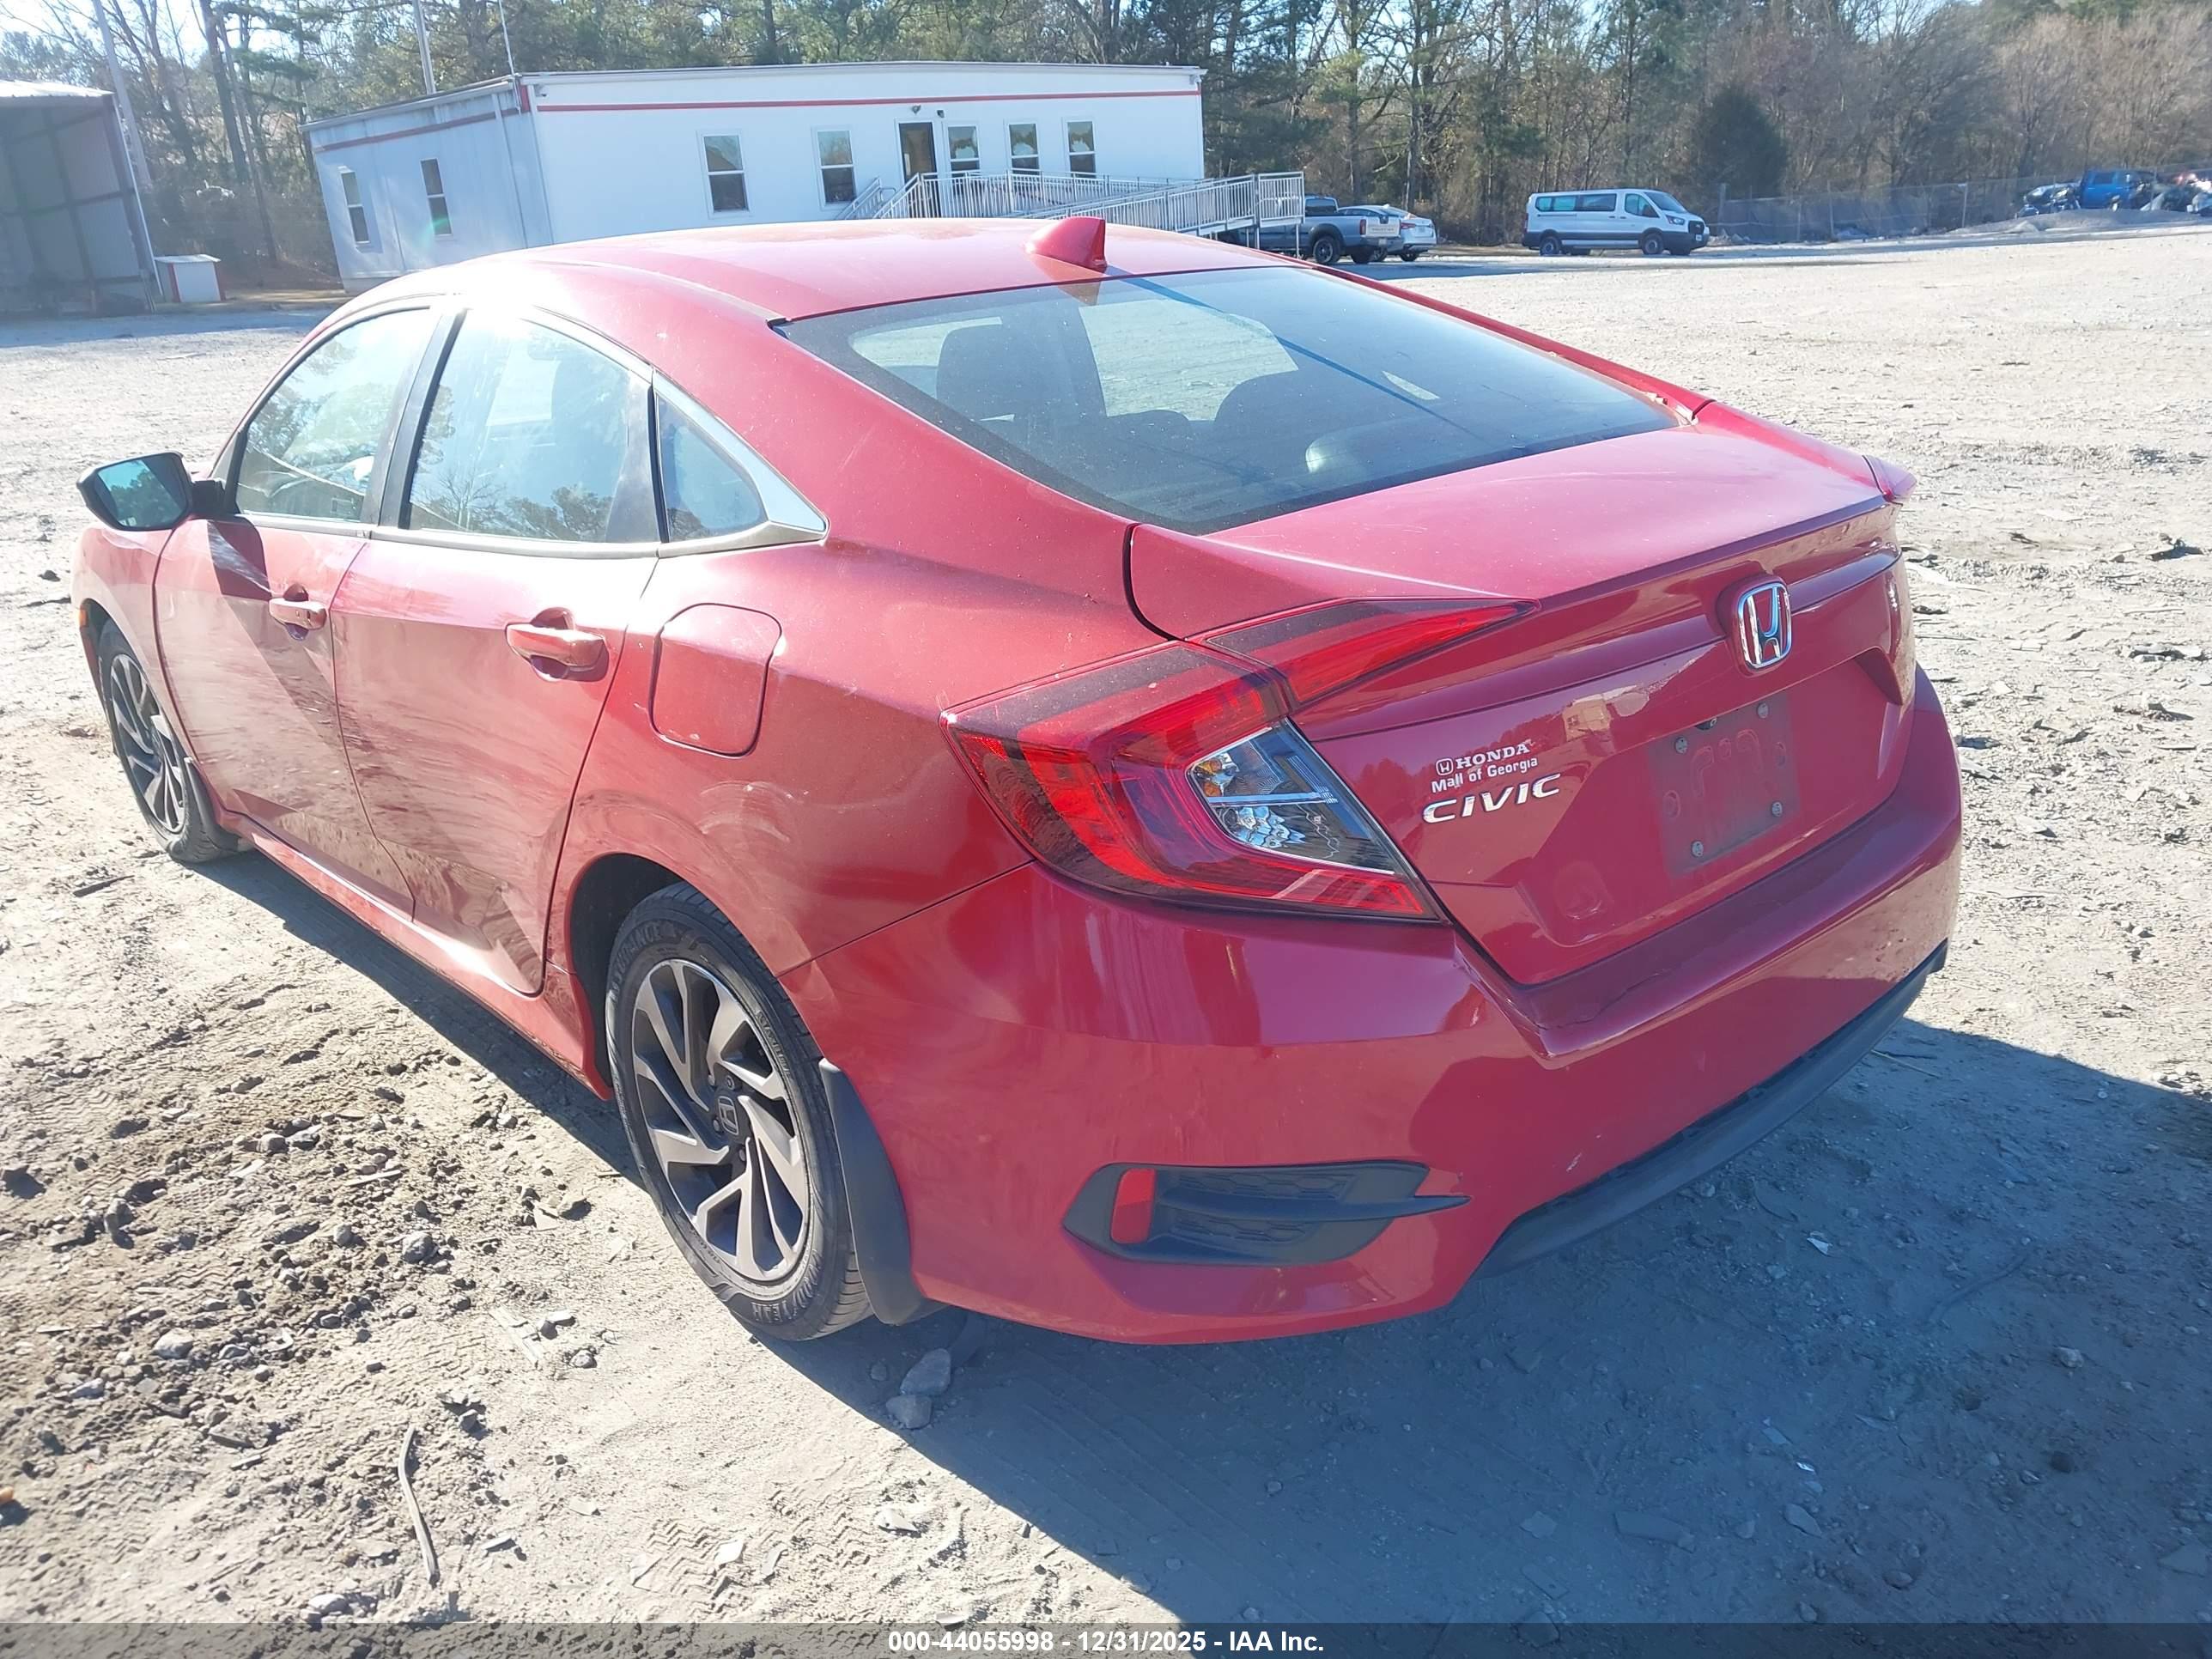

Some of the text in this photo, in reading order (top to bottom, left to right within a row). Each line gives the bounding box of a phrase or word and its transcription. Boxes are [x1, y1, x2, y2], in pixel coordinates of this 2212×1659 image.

[1455, 743, 1530, 769] HONDA
[1431, 757, 1538, 793] Mall of Georgia
[1422, 773, 1561, 823] CIVIC
